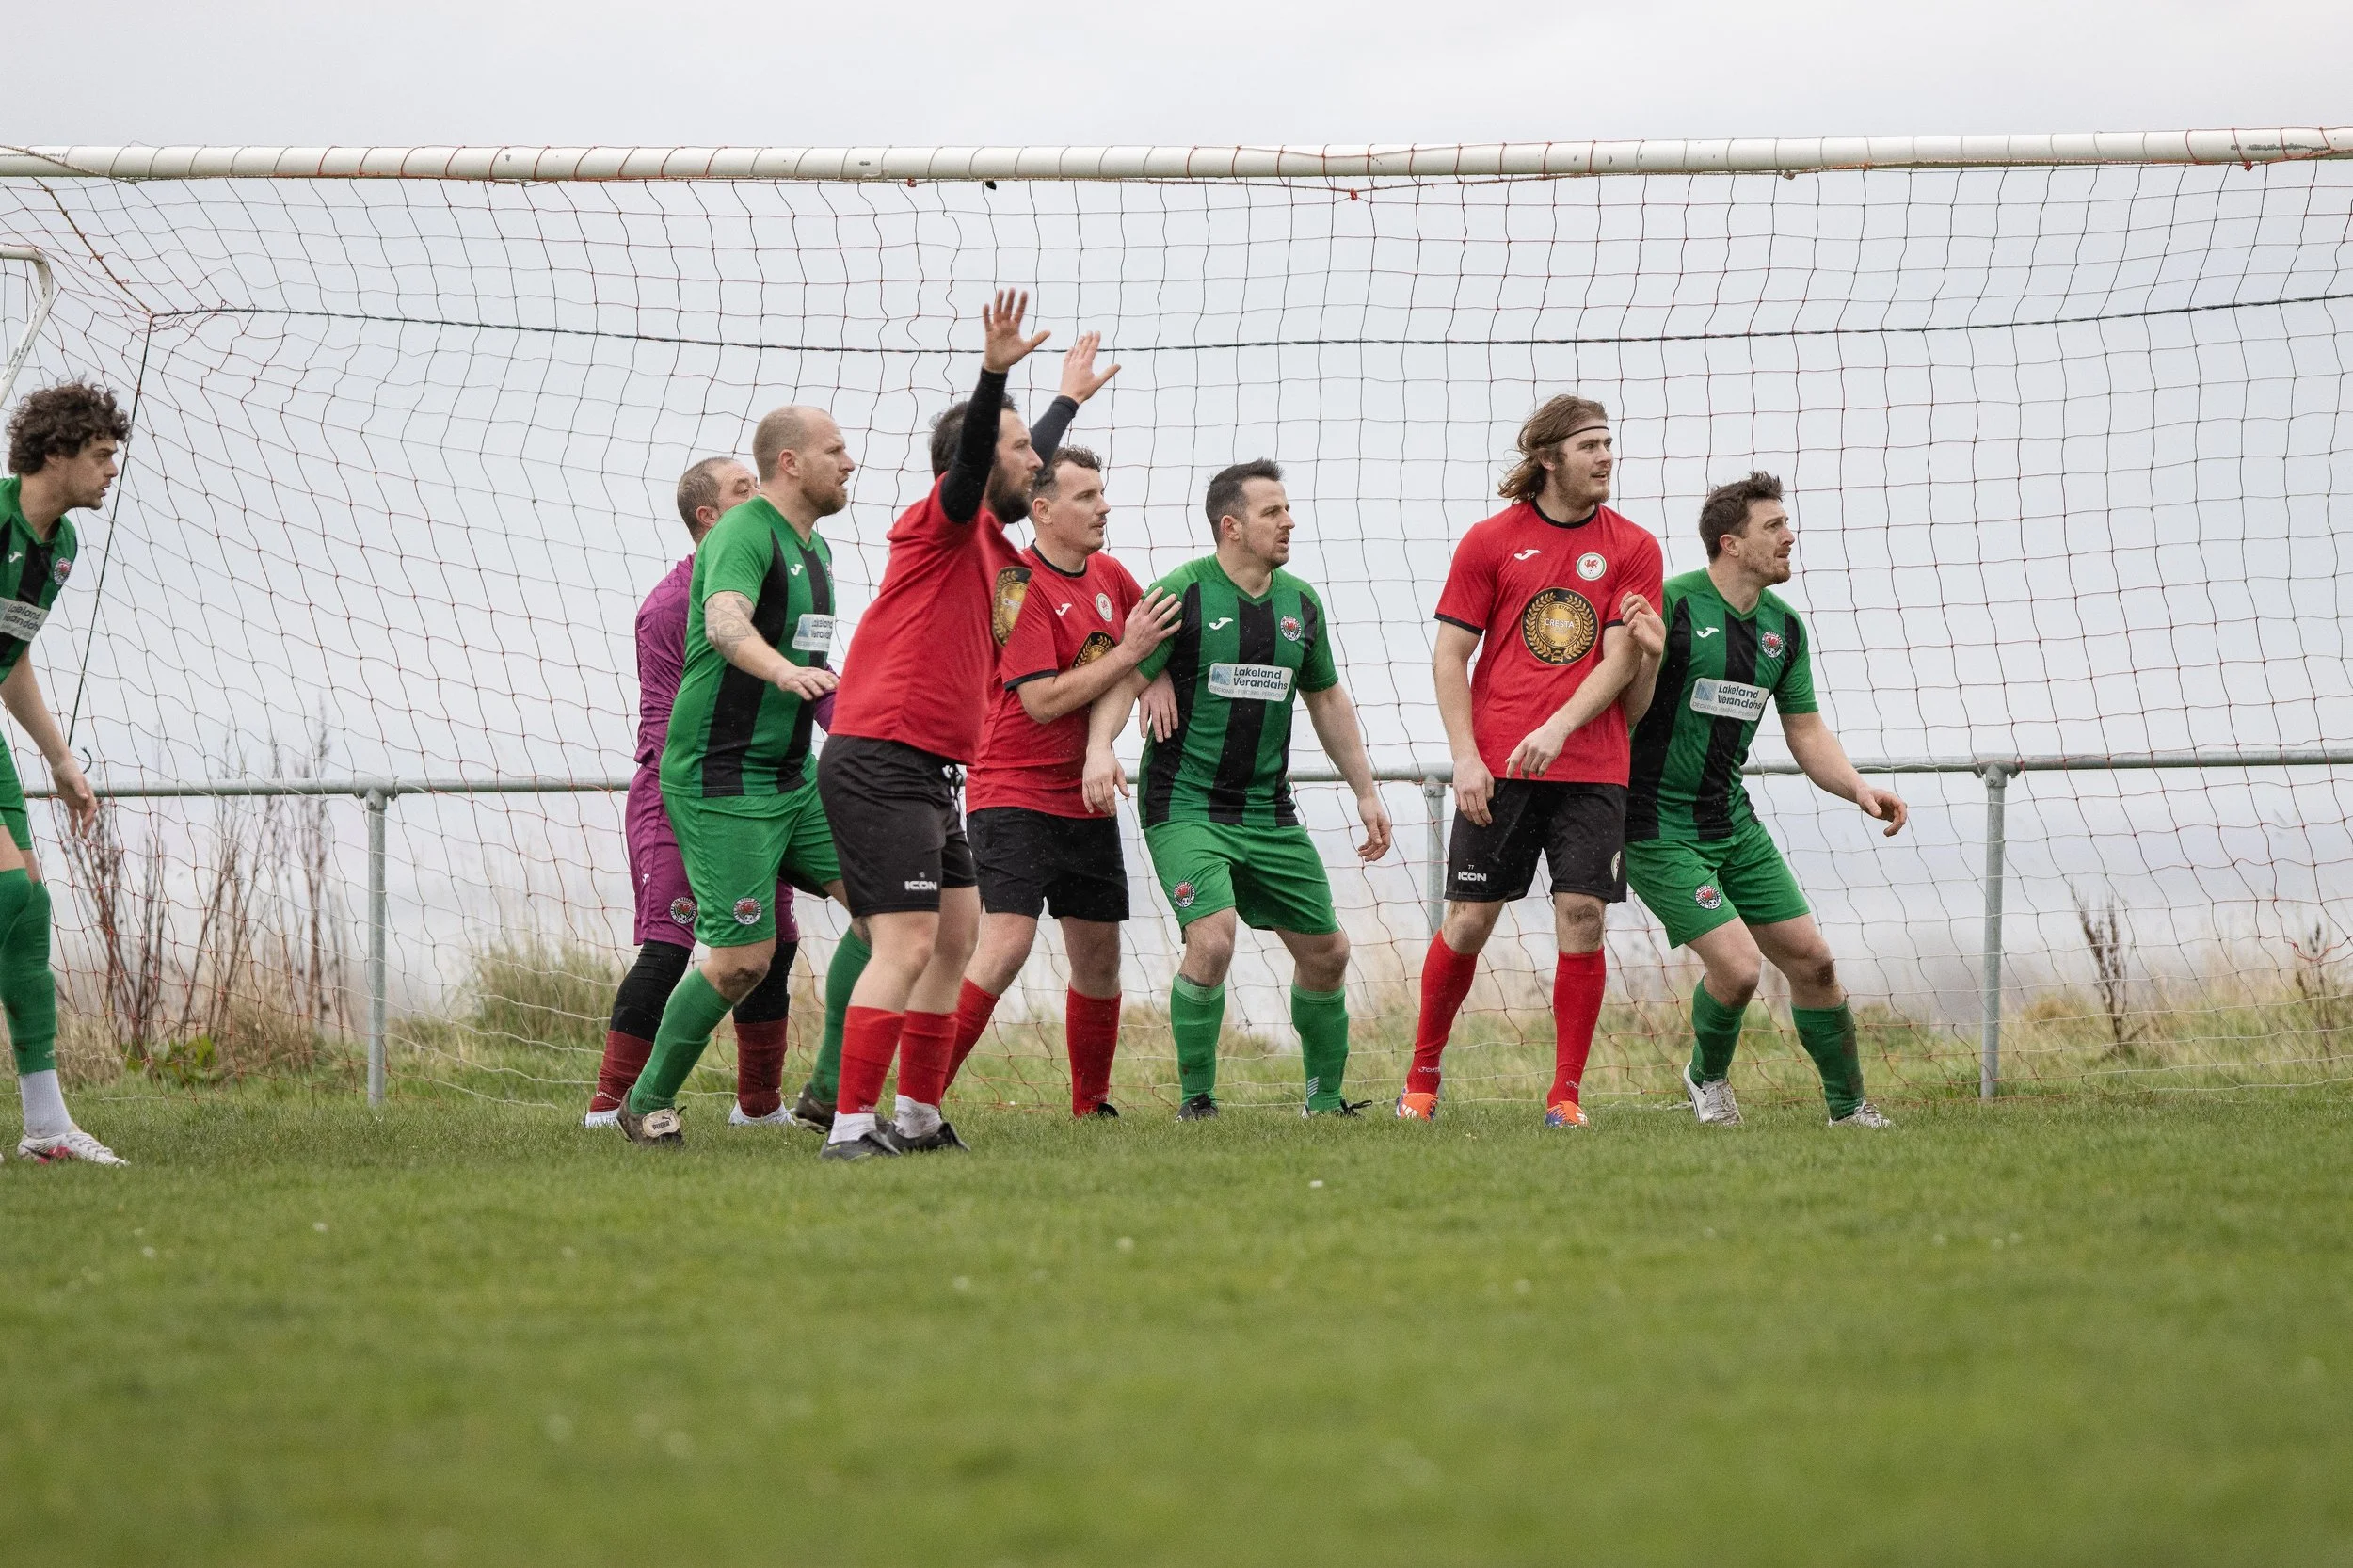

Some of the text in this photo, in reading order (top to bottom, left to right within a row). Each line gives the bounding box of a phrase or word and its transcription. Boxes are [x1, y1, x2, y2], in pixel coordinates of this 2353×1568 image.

[1545, 617, 1575, 629] CRESTA
[1234, 666, 1282, 680] Lakeland
[1233, 677, 1289, 691] Verandahs
[1718, 683, 1760, 699] Lakeland
[1718, 695, 1763, 710] Verandahs
[1458, 872, 1487, 882] ICON
[904, 880, 937, 890] ICON
